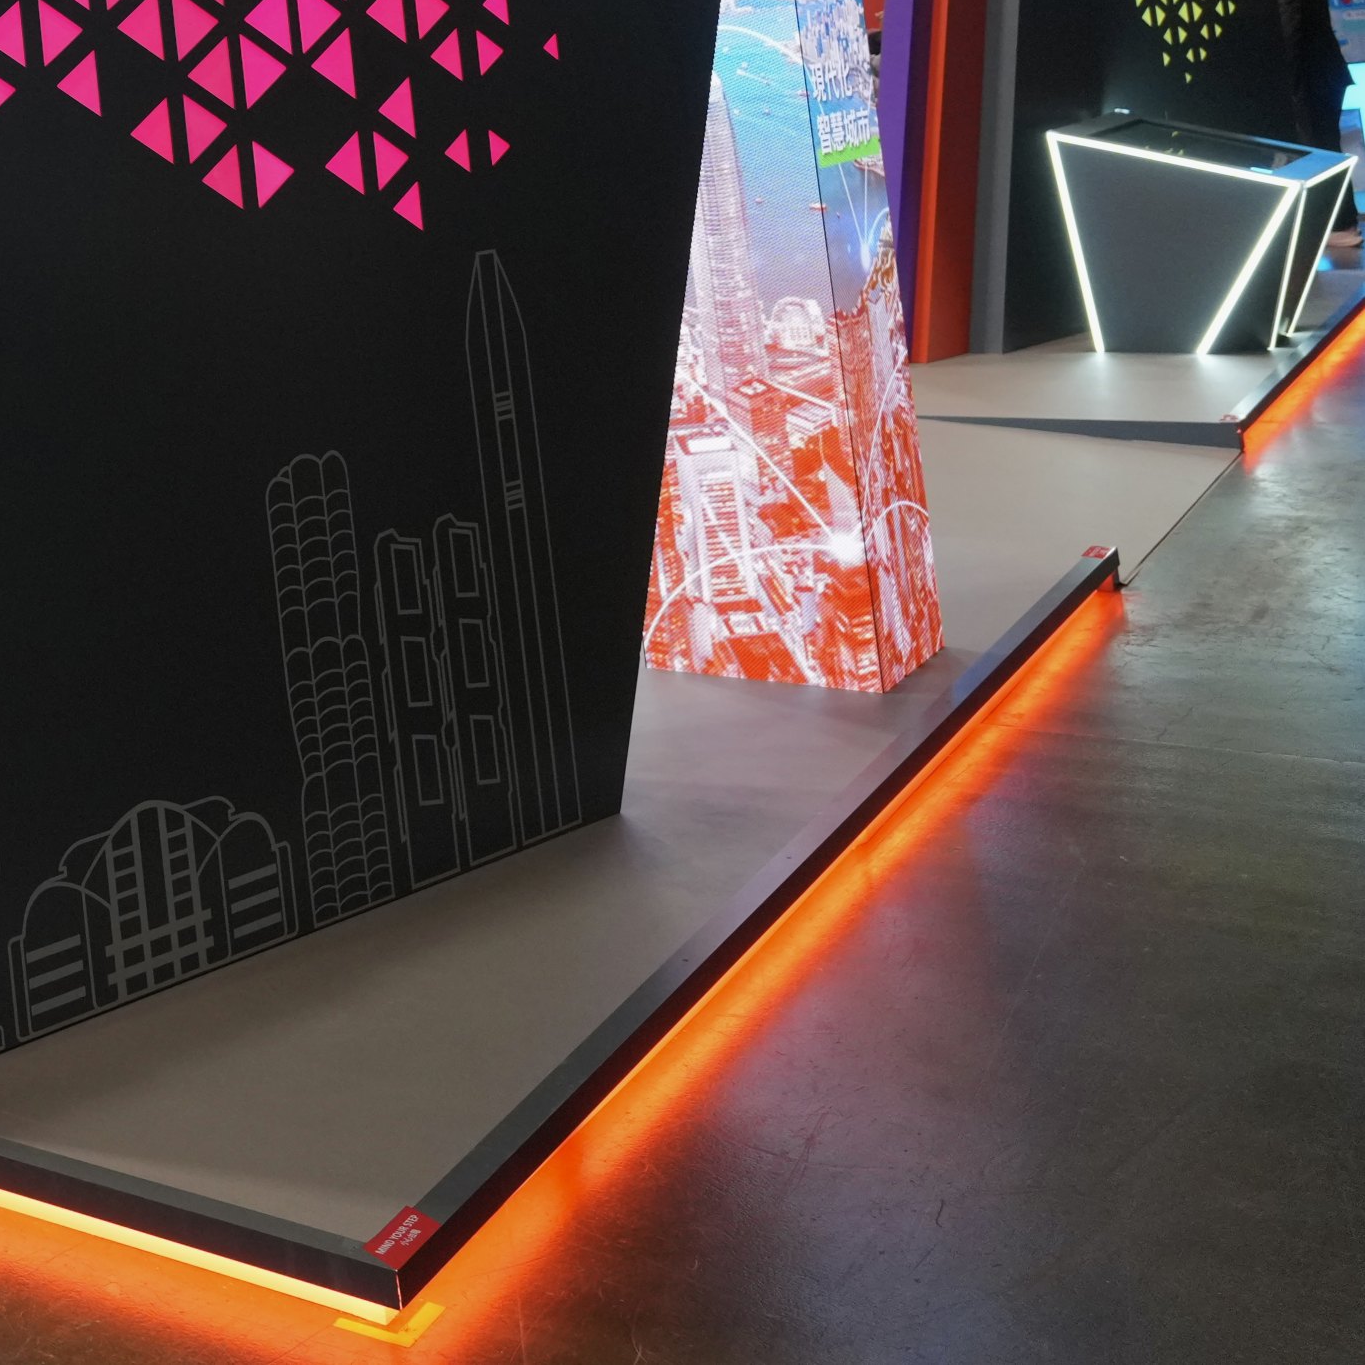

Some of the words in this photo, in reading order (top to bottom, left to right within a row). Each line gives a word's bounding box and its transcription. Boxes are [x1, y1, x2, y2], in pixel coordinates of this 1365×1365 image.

[811, 62, 853, 101] 現代化
[817, 108, 872, 156] 智慧城市
[375, 1239, 395, 1254] MIND
[389, 1225, 408, 1240] YOUR
[402, 1214, 419, 1227] STEP
